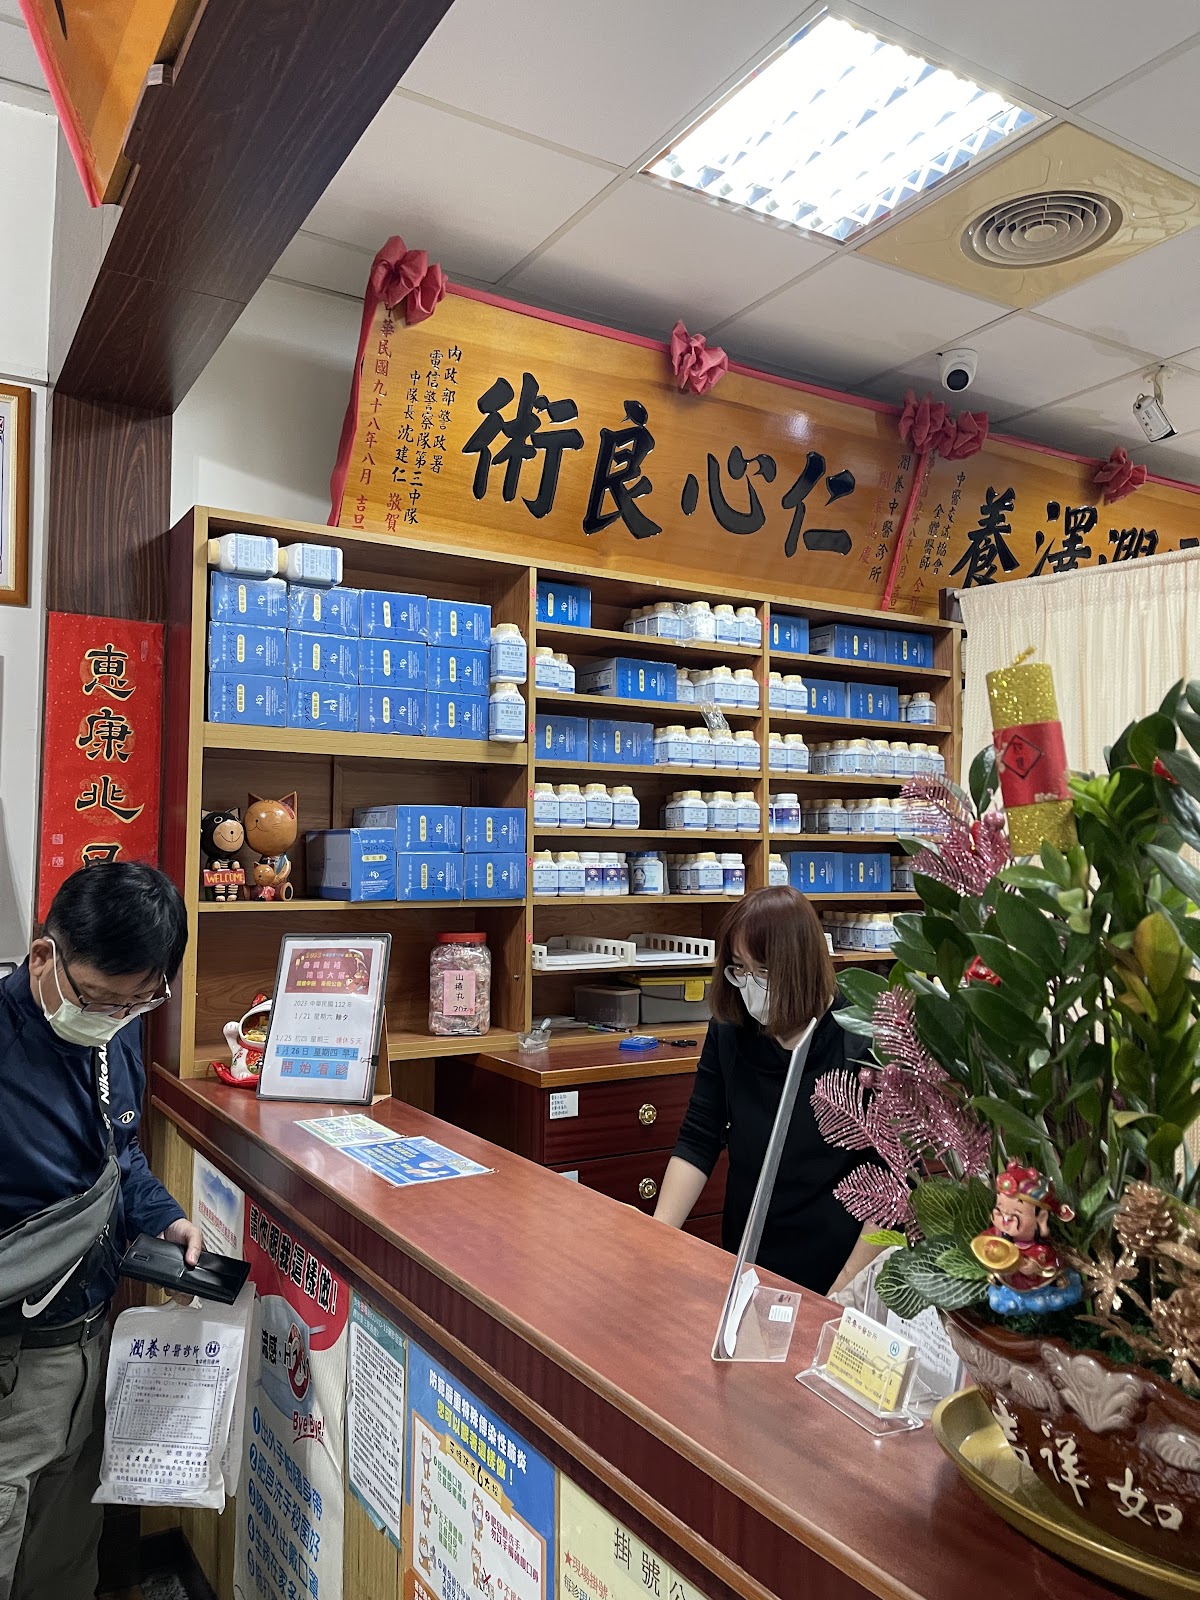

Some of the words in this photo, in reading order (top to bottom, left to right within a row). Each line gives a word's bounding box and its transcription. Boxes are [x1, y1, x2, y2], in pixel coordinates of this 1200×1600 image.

[392, 370, 421, 482] 中隊長沈建仁
[430, 344, 463, 474] 內政部警政署
[869, 454, 911, 583] 潤養中醫診所
[919, 503, 945, 571] 全體醫師
[932, 471, 966, 575] 中醫交流協會
[205, 872, 243, 883] WELCOME
[281, 1060, 349, 1076] 開始看診
[129, 1338, 200, 1359] 潤養中醫診所
[293, 1411, 308, 1437] Bye
